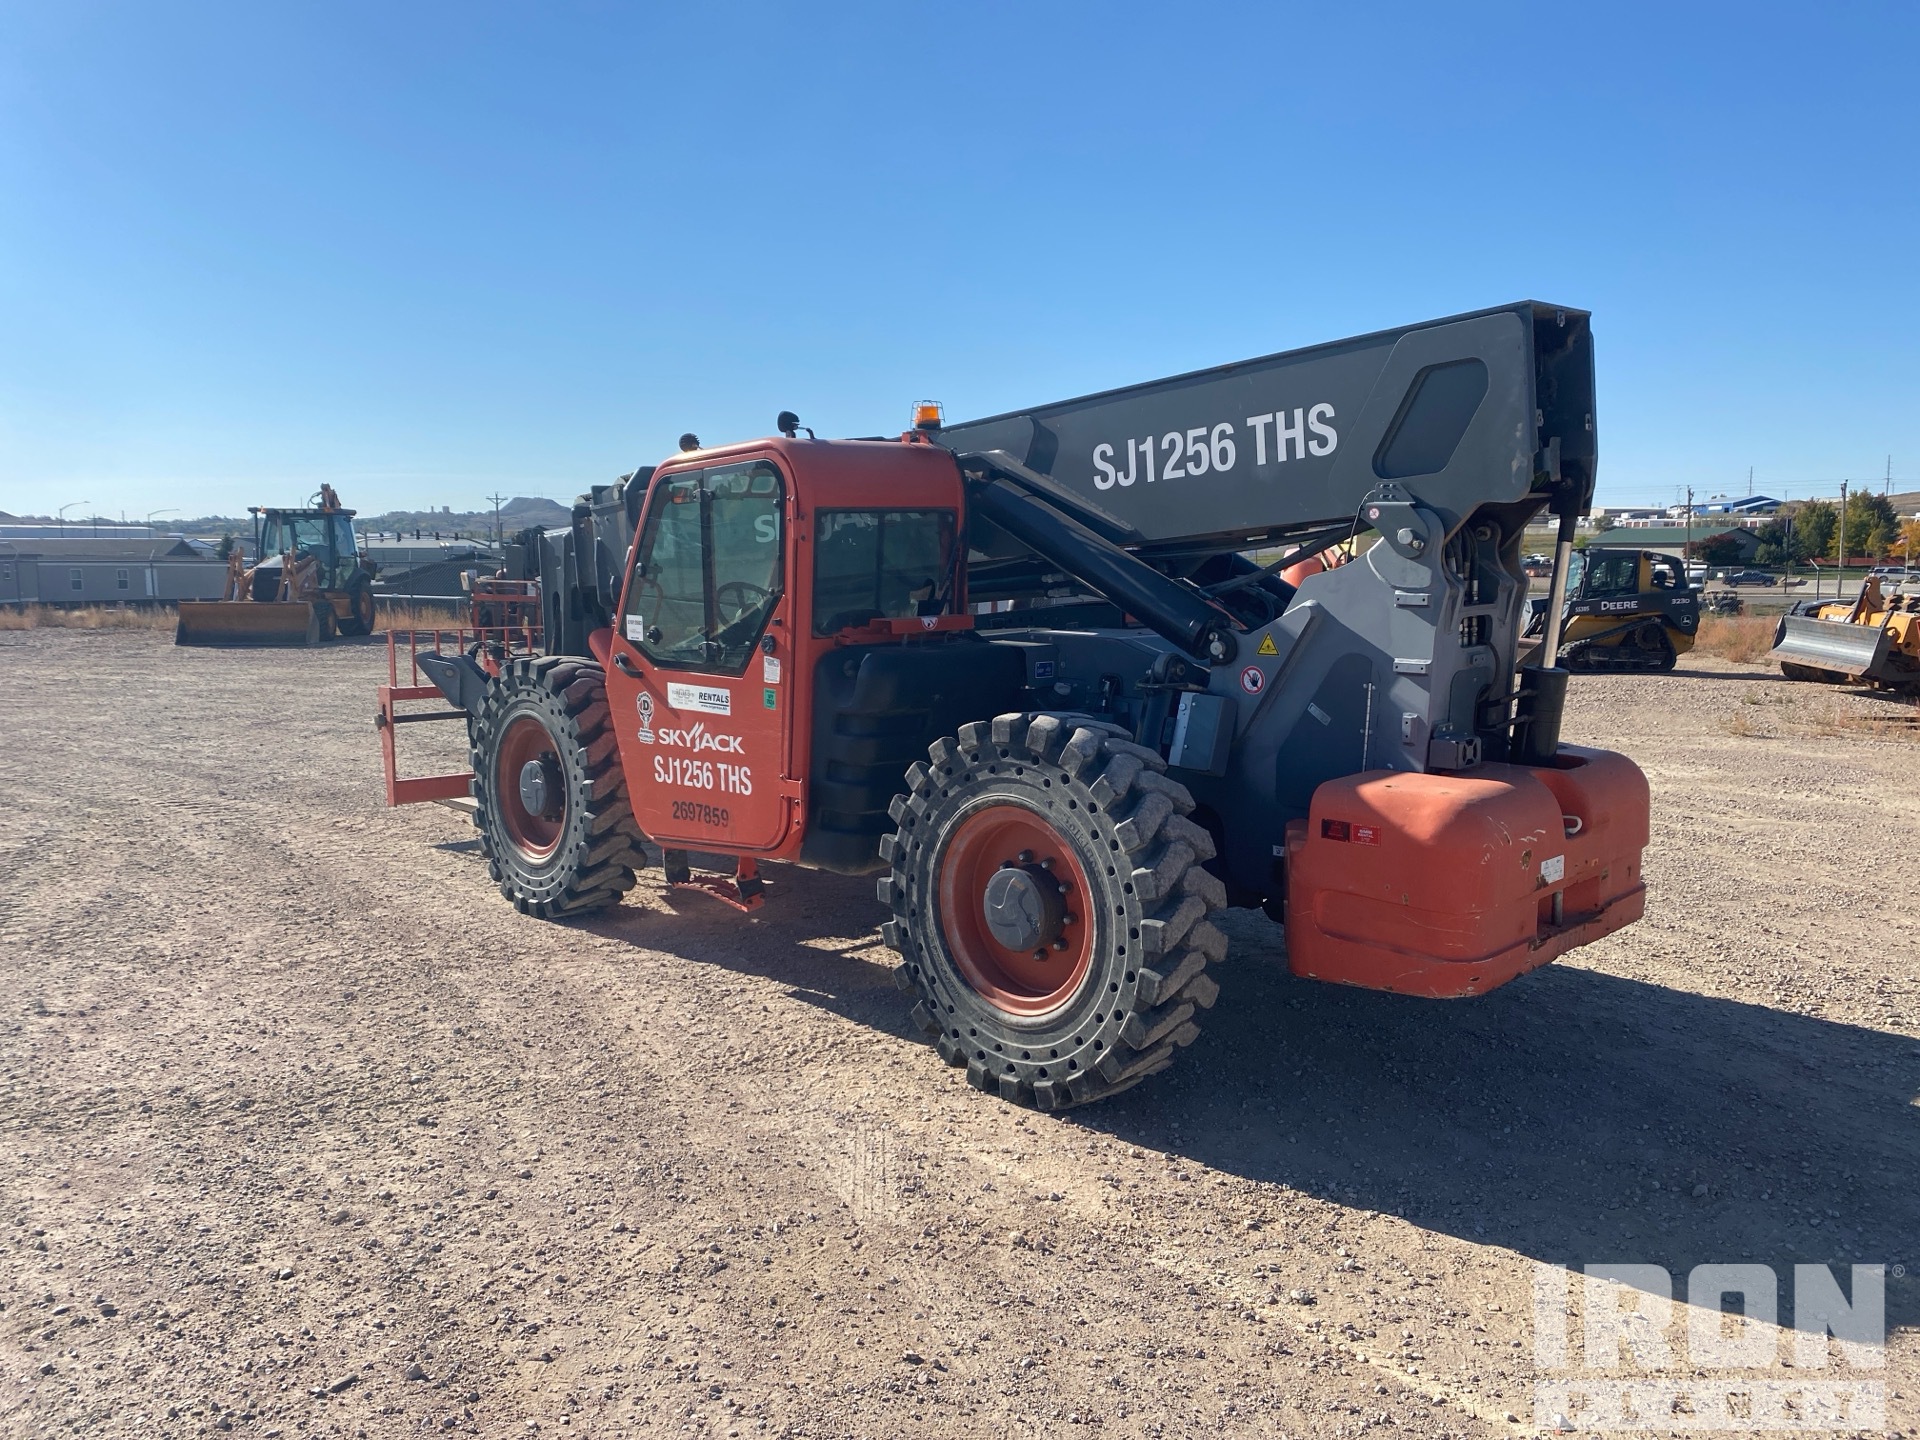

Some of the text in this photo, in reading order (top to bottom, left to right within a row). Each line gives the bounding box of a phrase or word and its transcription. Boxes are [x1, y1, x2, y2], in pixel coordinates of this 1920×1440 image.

[1092, 402, 1338, 490] SJ1256 THS
[1601, 600, 1638, 611] DEERE
[698, 691, 730, 704] RENTALS
[658, 721, 746, 755] SKYJACK
[654, 755, 752, 795] SJ1256 THS
[672, 801, 729, 827] 2697859
